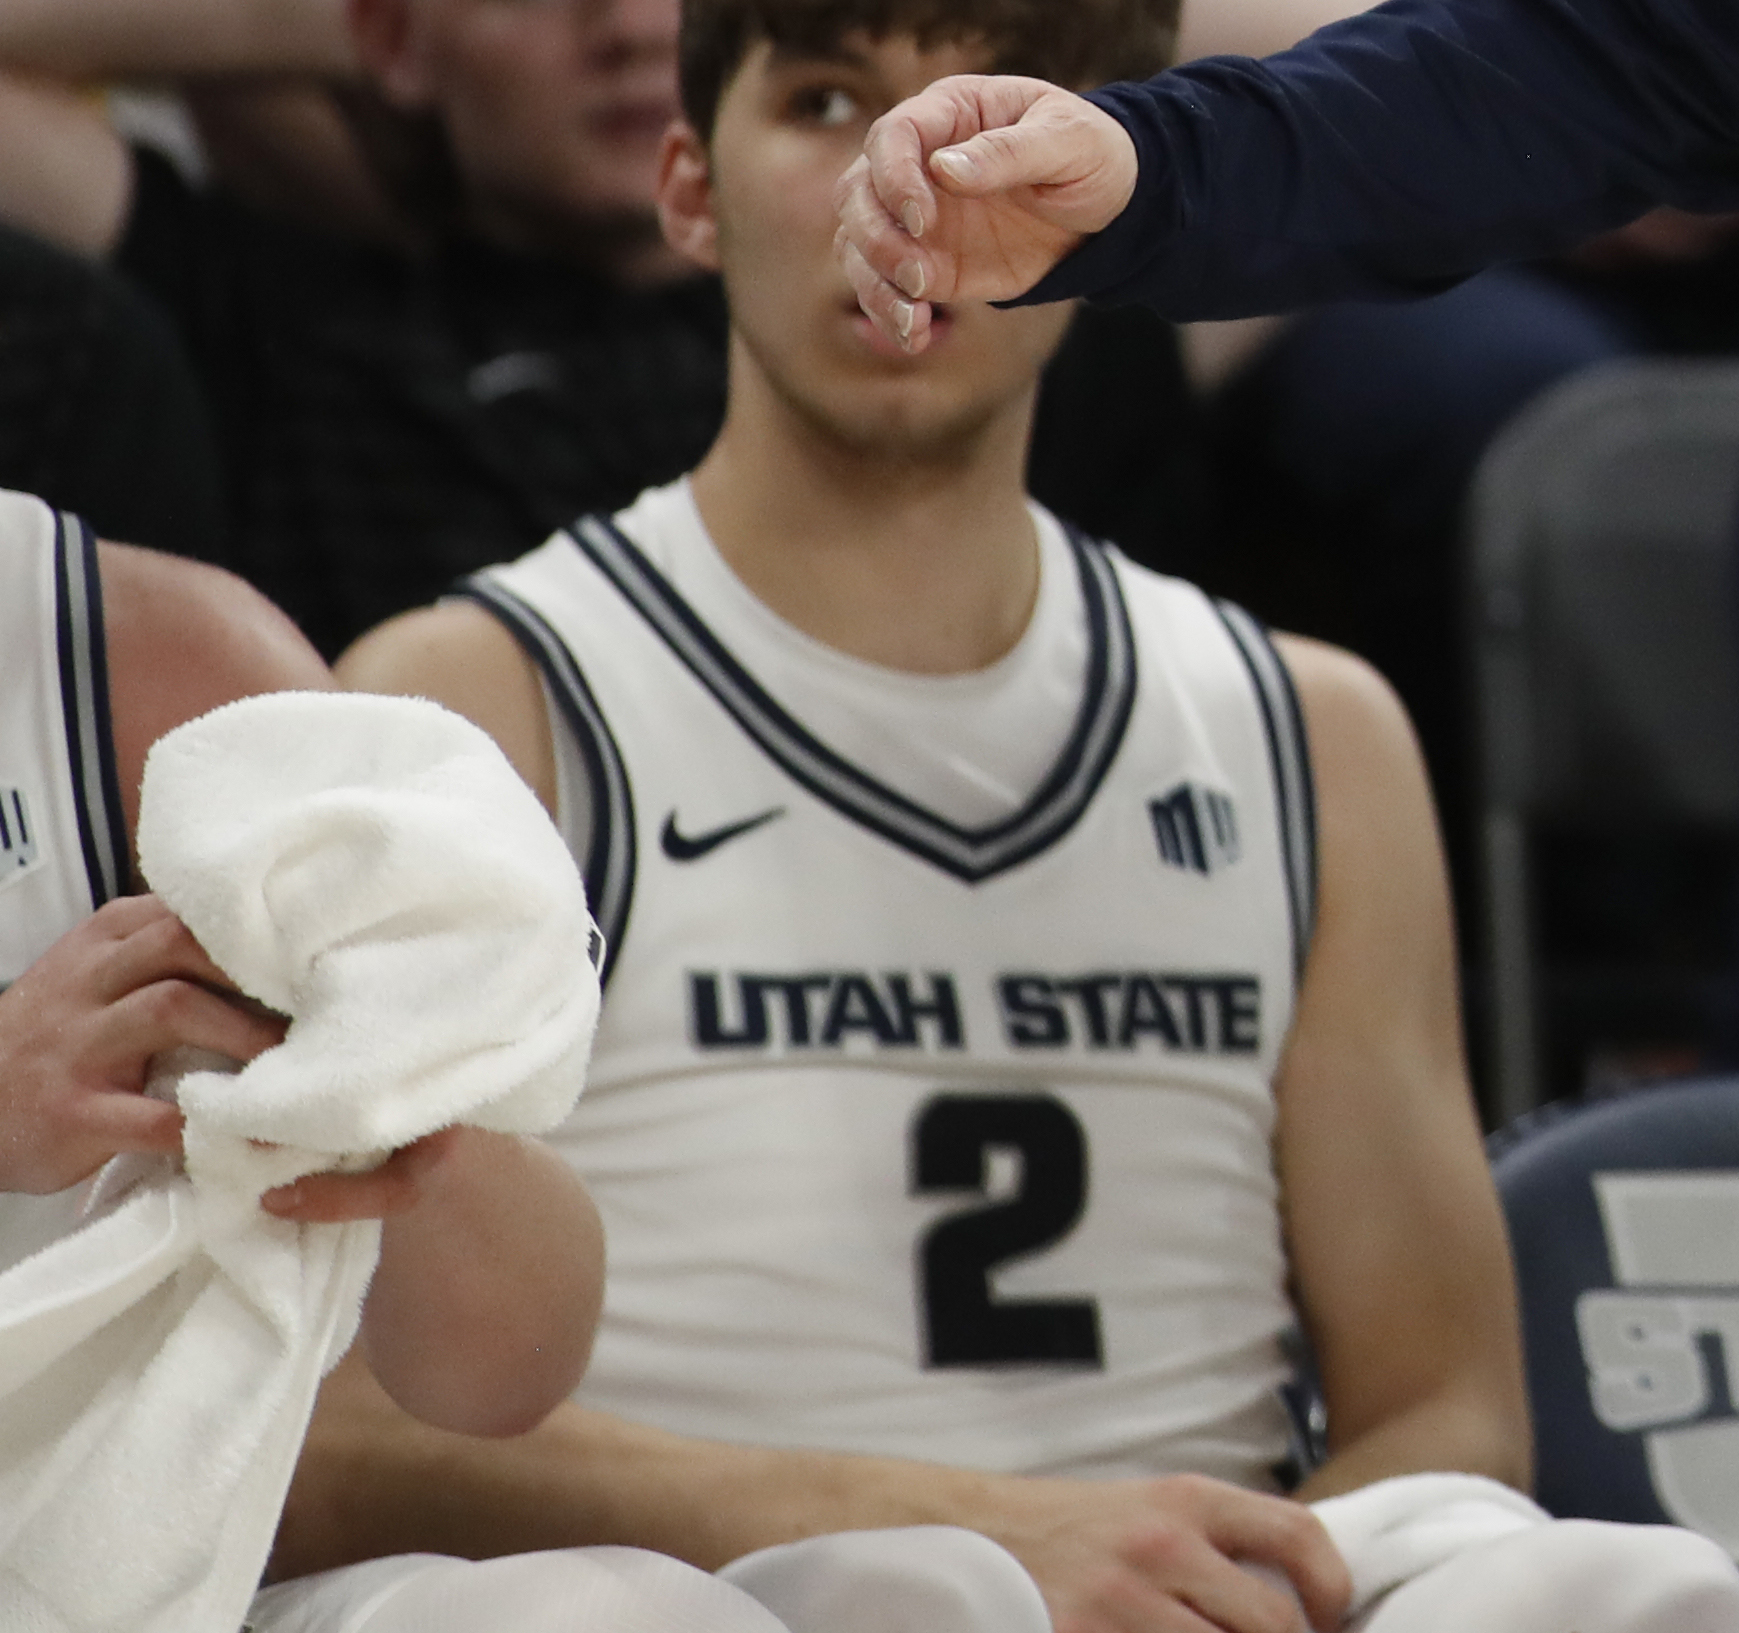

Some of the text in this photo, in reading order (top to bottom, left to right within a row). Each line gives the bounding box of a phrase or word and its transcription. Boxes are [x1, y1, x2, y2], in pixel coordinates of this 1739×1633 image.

[690, 971, 1260, 1053] UTAH STATE
[908, 1092, 1104, 1369] 2
